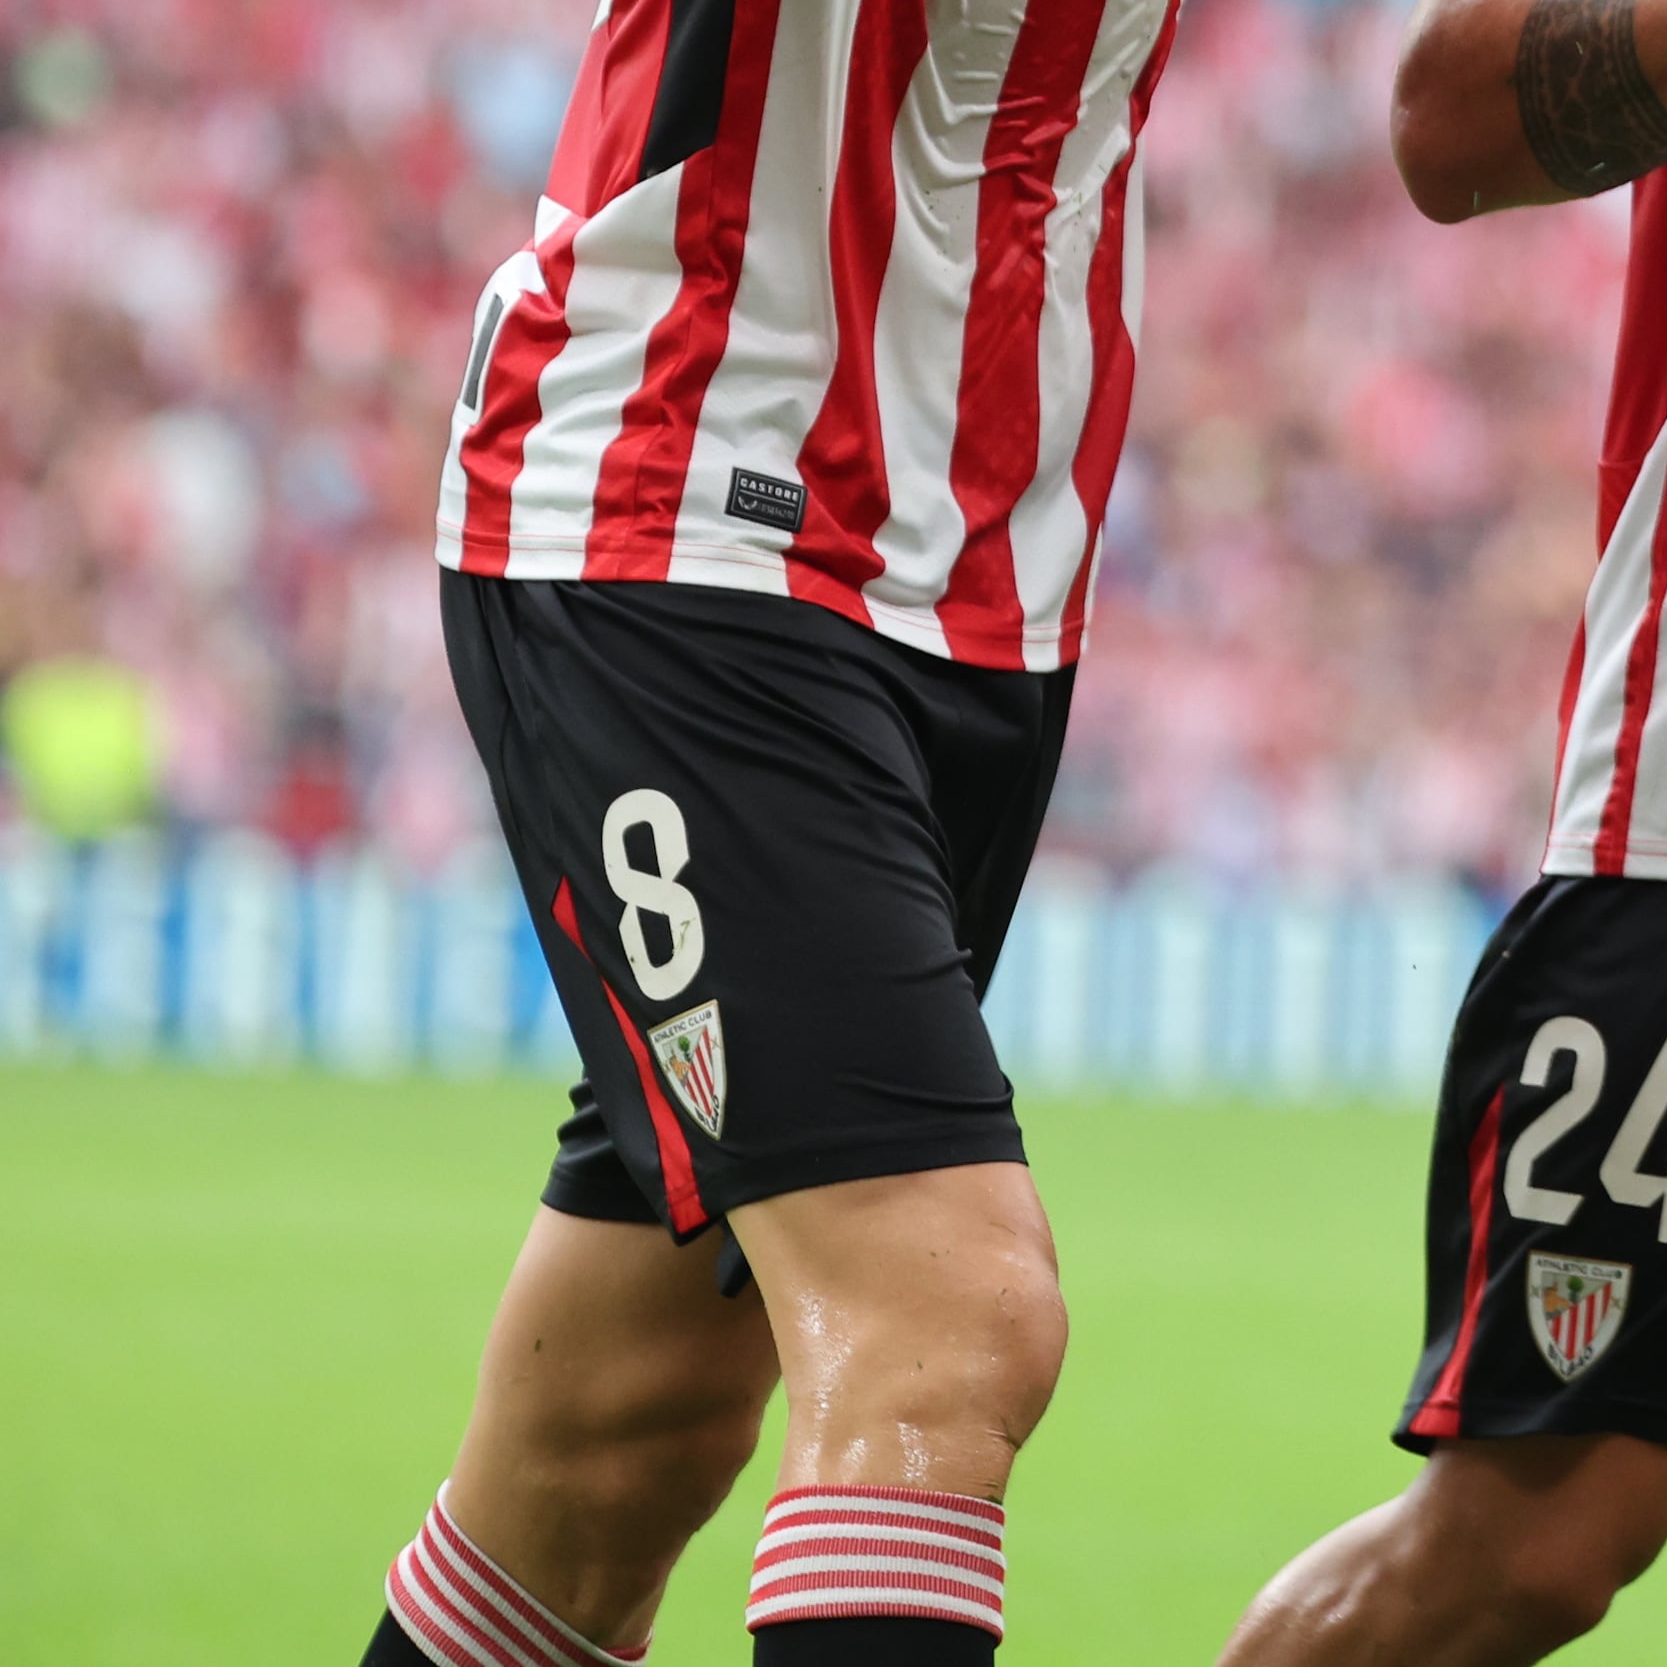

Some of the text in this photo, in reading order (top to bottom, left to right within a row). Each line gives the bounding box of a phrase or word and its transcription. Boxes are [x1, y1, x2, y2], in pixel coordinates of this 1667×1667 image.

[739, 477, 800, 502] CASTORE
[602, 788, 705, 1001] 8
[688, 1010, 712, 1027] CLUB
